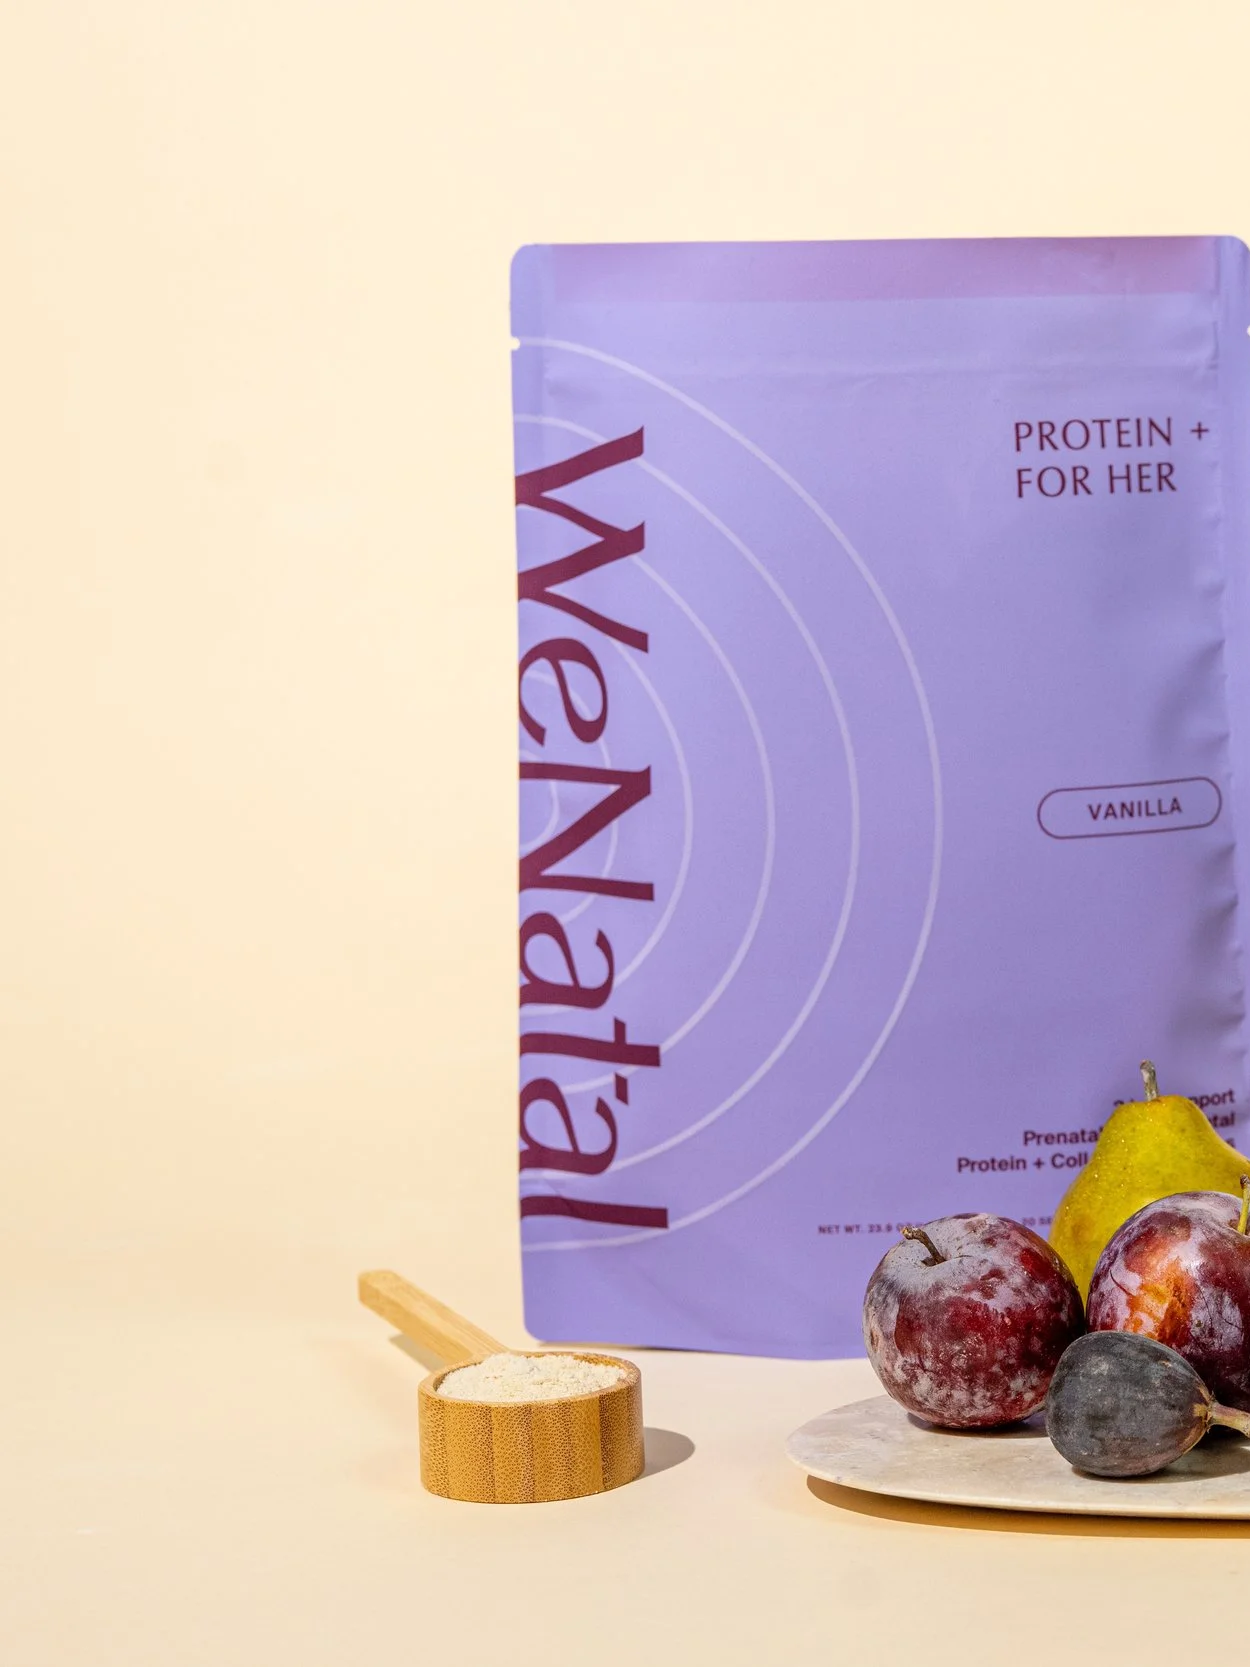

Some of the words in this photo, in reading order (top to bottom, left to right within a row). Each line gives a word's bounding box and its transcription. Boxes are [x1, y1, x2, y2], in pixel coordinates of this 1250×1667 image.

[1014, 416, 1172, 452] PROTEIN
[1190, 421, 1210, 441] +
[1016, 466, 1093, 498] FOR
[1108, 462, 1177, 494] HER
[1087, 797, 1183, 821] VANILLA
[514, 425, 669, 1230] WeNatal
[957, 1156, 1027, 1173] Protein
[1033, 1157, 1045, 1169] +
[1051, 1152, 1089, 1168] Coll
[818, 1224, 840, 1234] NET
